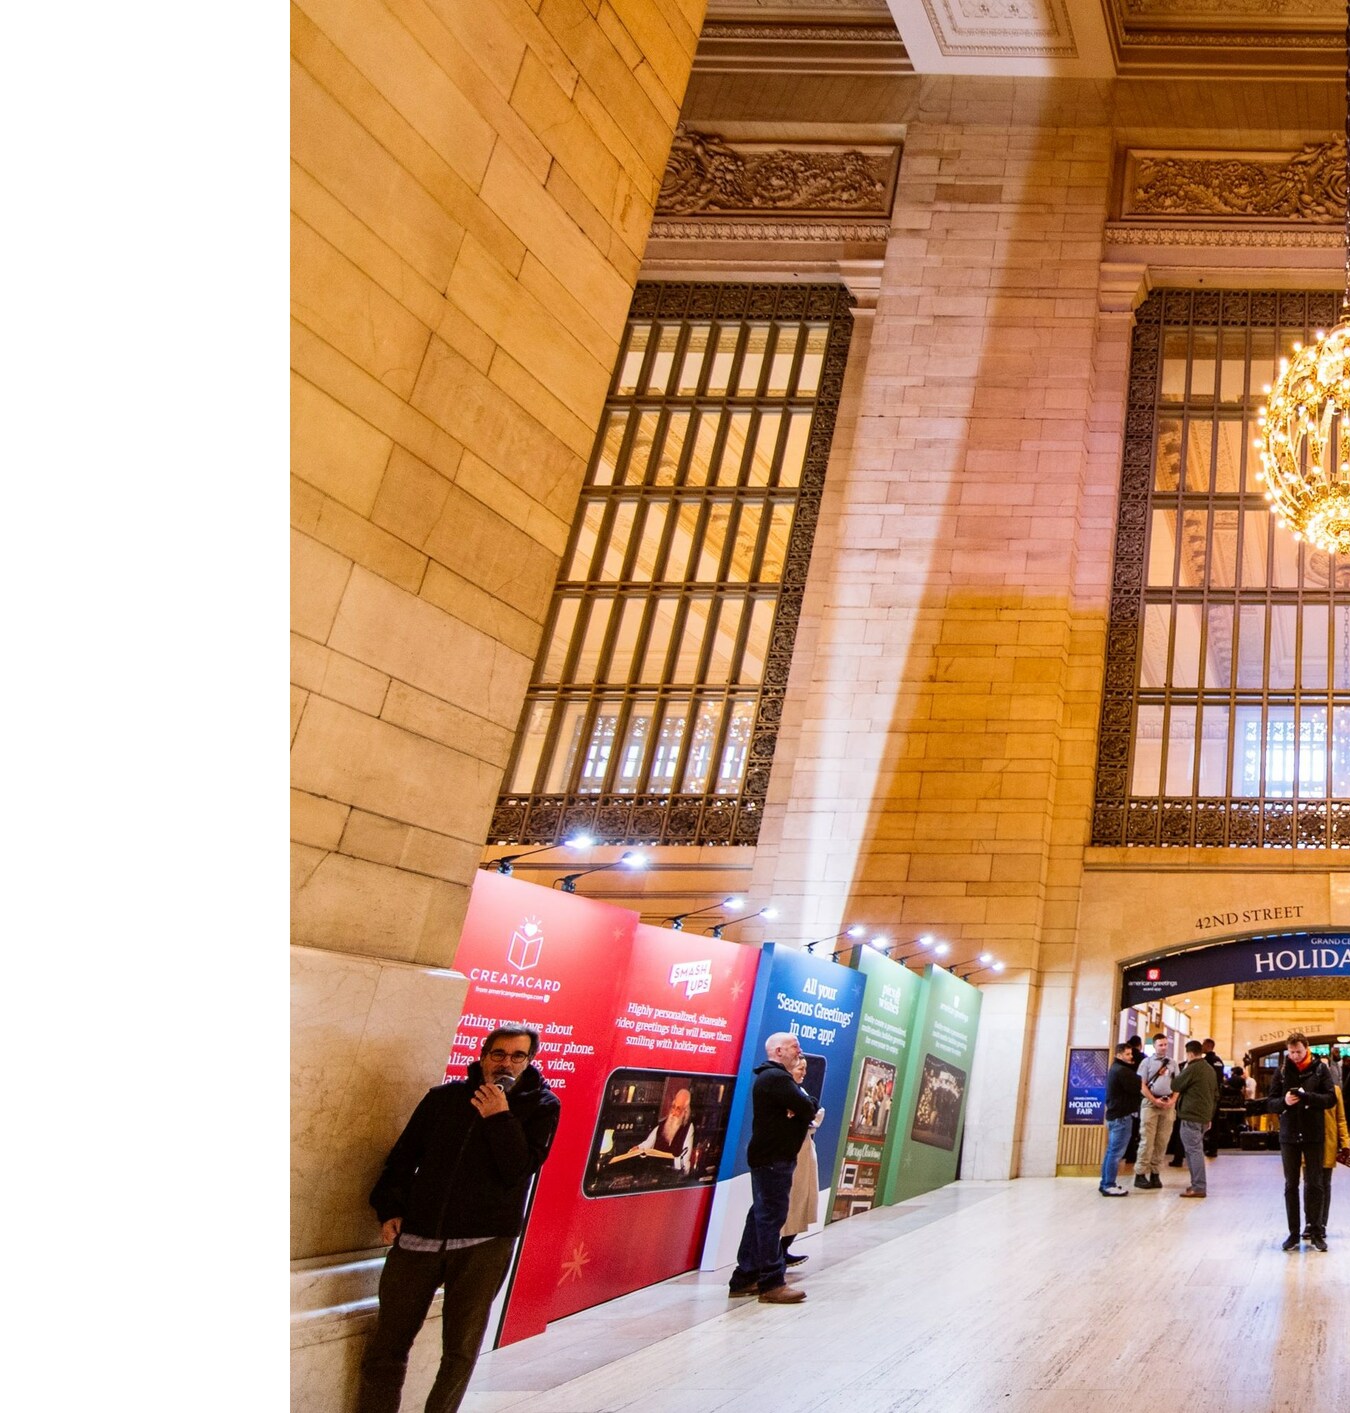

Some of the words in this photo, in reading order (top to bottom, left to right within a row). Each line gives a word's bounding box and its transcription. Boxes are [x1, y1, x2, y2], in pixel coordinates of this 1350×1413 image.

[1195, 912, 1239, 929] 42ND
[1242, 906, 1304, 923] STREET
[674, 964, 708, 979] SMASH
[470, 968, 561, 992] CREATACARD
[690, 979, 709, 991] UPS
[803, 977, 818, 995] All
[817, 984, 838, 1000] your
[628, 1002, 654, 1017] Highly
[545, 1022, 573, 1035] about
[635, 1021, 670, 1035] greetings
[671, 1025, 685, 1036] that
[686, 1027, 699, 1037] will
[790, 1019, 799, 1036] in
[801, 1024, 817, 1039] one
[817, 1028, 836, 1046] app!
[1259, 1031, 1285, 1042] 42ND
[539, 1041, 562, 1053] your
[563, 1041, 594, 1055] phone.
[626, 1035, 655, 1050] smiling
[656, 1038, 673, 1049] with
[673, 1040, 698, 1054] holiday
[547, 1059, 575, 1073] video,
